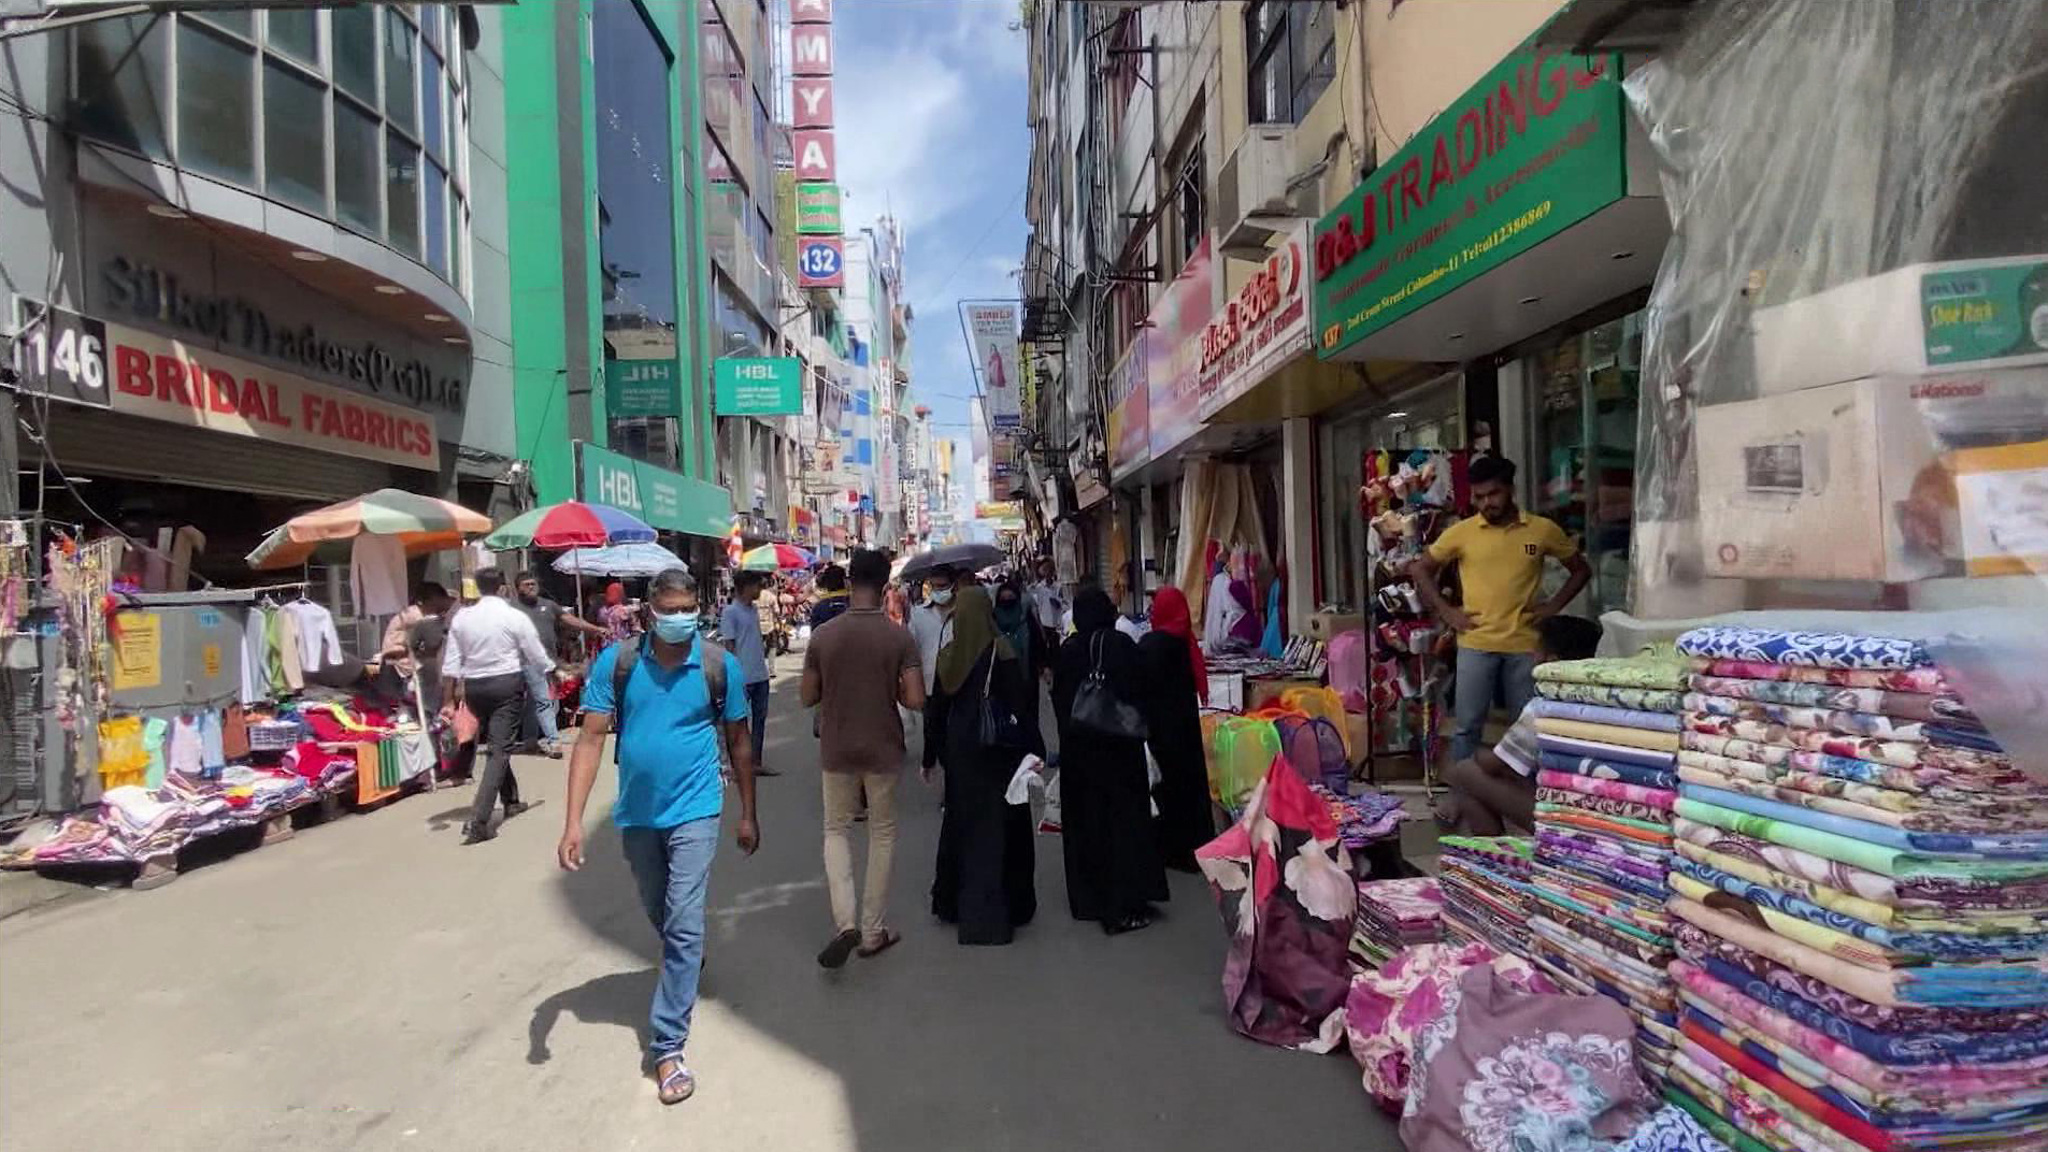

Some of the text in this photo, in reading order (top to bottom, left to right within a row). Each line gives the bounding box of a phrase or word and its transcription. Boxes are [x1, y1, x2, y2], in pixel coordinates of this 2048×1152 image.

[801, 247, 835, 273] 132
[29, 328, 104, 388] 146
[735, 365, 780, 380] HBL
[114, 344, 433, 457] BRIDAL FABRICS
[599, 464, 643, 511] HBL
